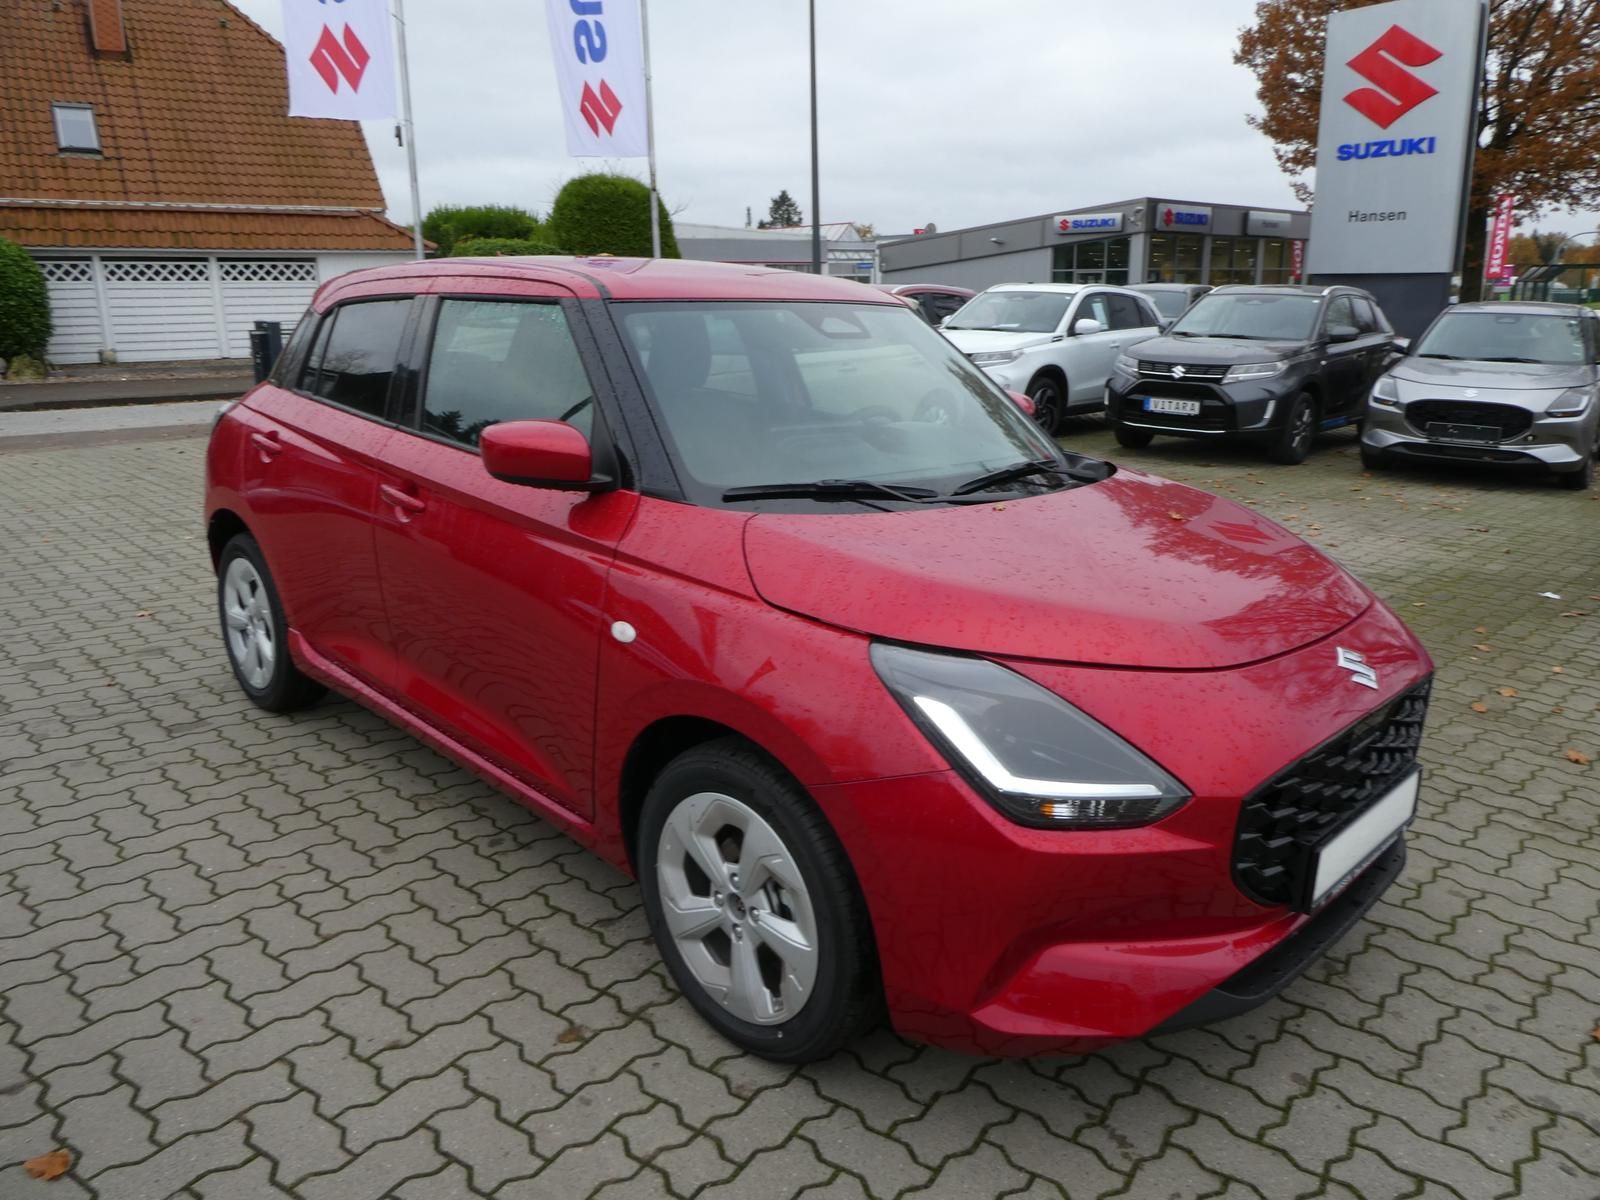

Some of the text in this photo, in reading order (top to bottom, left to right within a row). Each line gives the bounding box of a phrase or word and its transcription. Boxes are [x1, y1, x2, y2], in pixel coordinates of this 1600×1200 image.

[1337, 136, 1436, 161] SUZUKI
[1348, 210, 1407, 222] Hansen
[1072, 218, 1116, 229] SUZUKI
[1152, 400, 1197, 411] VITARA
